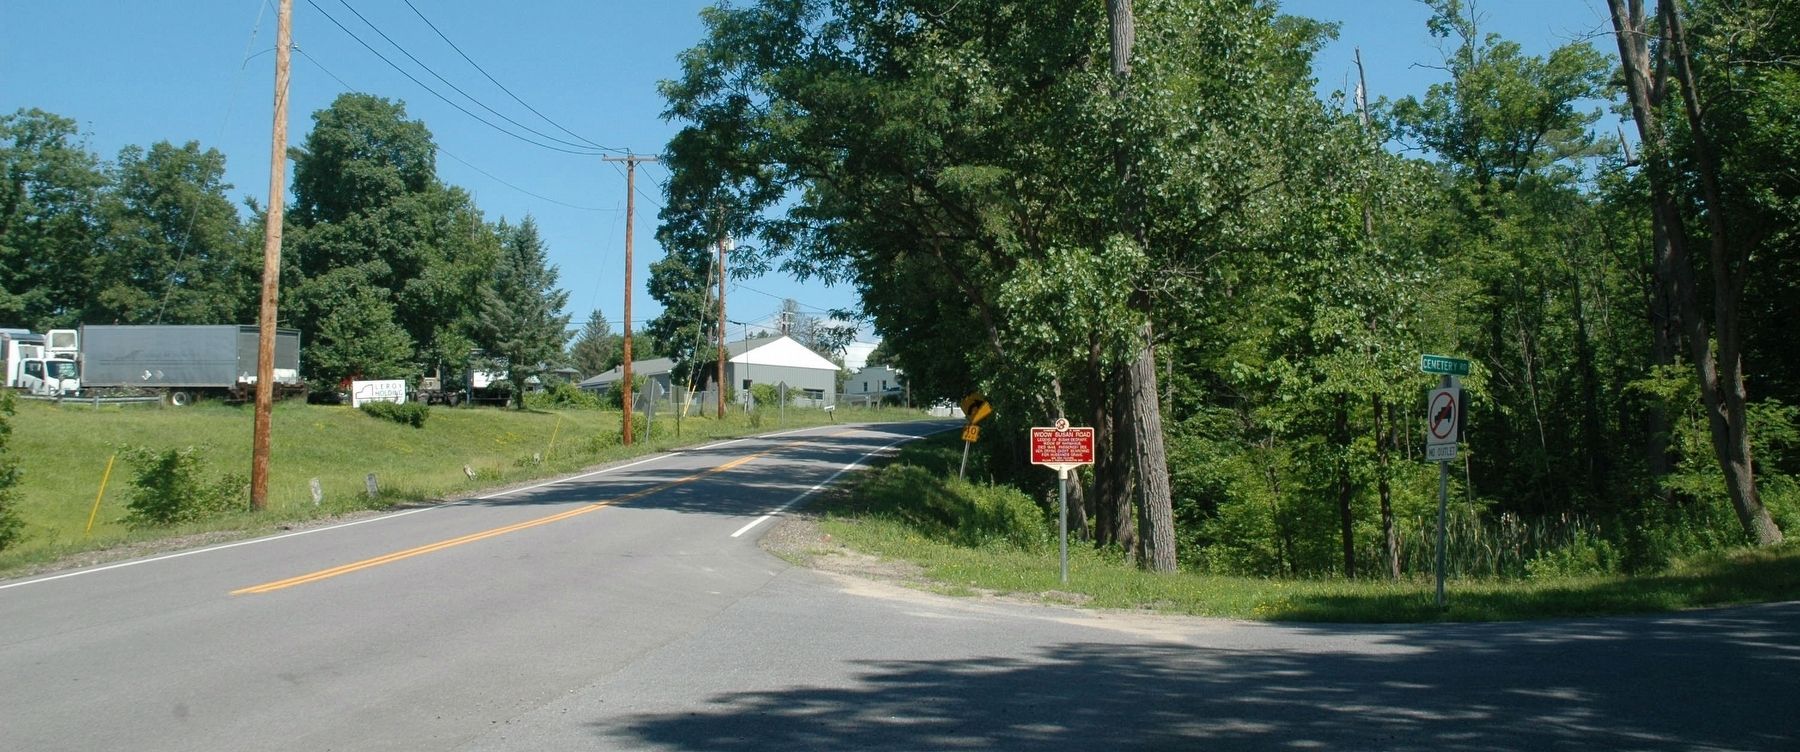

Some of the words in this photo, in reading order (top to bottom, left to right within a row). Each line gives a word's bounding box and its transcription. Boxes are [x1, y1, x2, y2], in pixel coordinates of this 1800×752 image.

[1423, 358, 1458, 371] CEMETERY
[1428, 447, 1436, 457] NO
[1437, 446, 1455, 457] OUTLET
